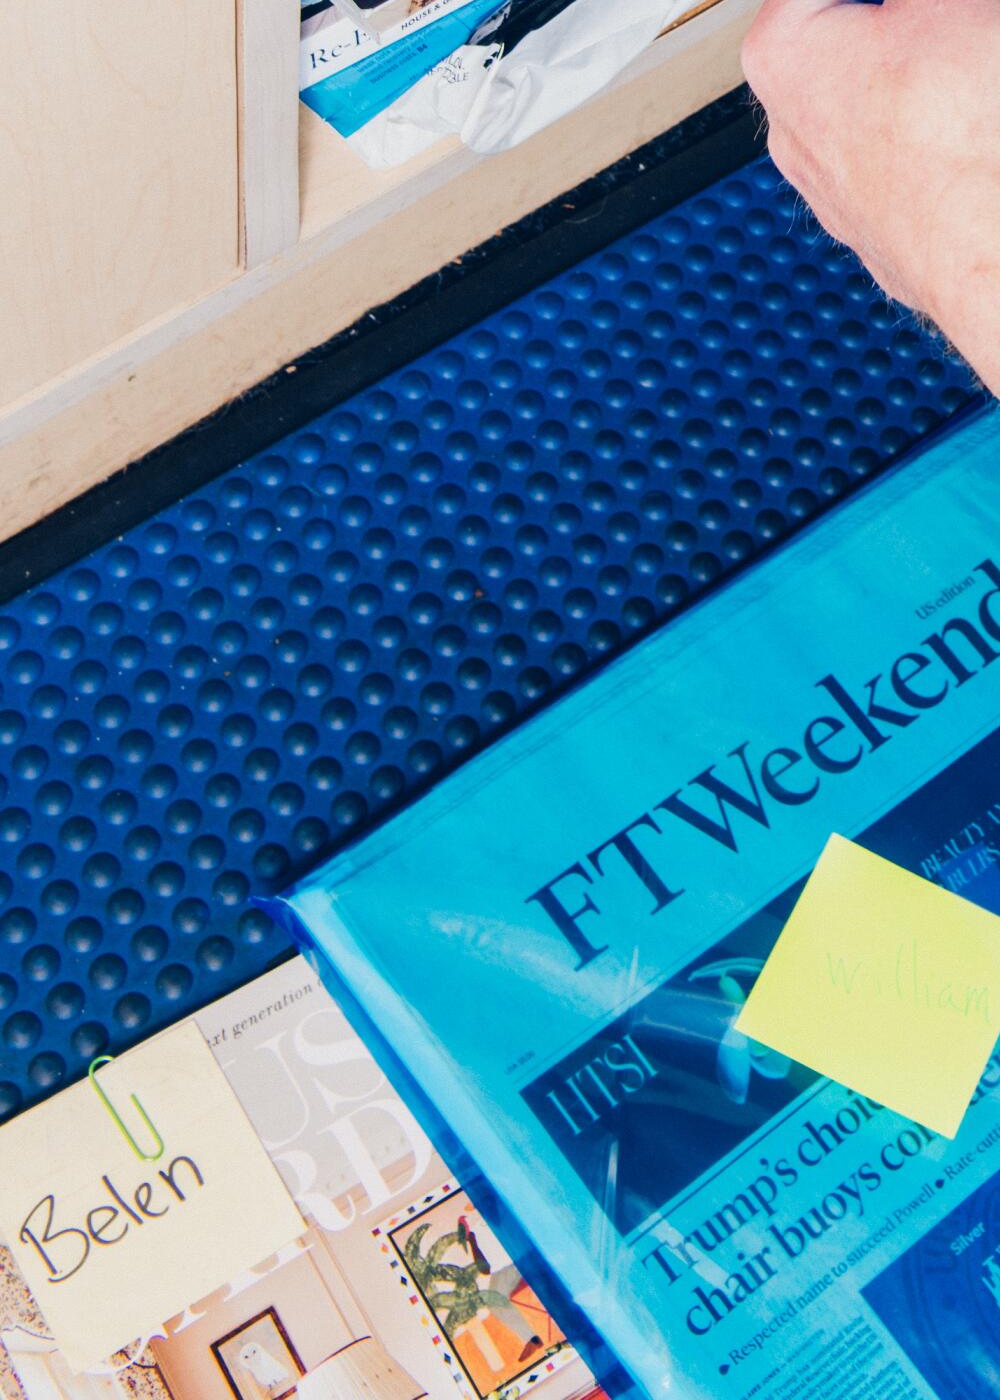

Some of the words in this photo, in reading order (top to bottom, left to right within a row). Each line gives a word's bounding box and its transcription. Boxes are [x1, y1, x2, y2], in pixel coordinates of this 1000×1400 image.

[399, 6, 435, 31] HOUSE
[912, 600, 938, 624] US
[929, 571, 978, 611] edition
[523, 809, 698, 974] FT
[232, 983, 315, 1041] generation
[545, 1030, 658, 1137] HTSI
[19, 1156, 205, 1284] Belen
[639, 1145, 802, 1291] Trump's
[674, 1236, 783, 1340] chair
[767, 1157, 886, 1261] buoys
[727, 1300, 798, 1367] Respected
[794, 1271, 835, 1310] name
[829, 1258, 850, 1279] to
[842, 1215, 897, 1266] succeed
[892, 1181, 937, 1225] Powell
[948, 1221, 988, 1257] Silver
